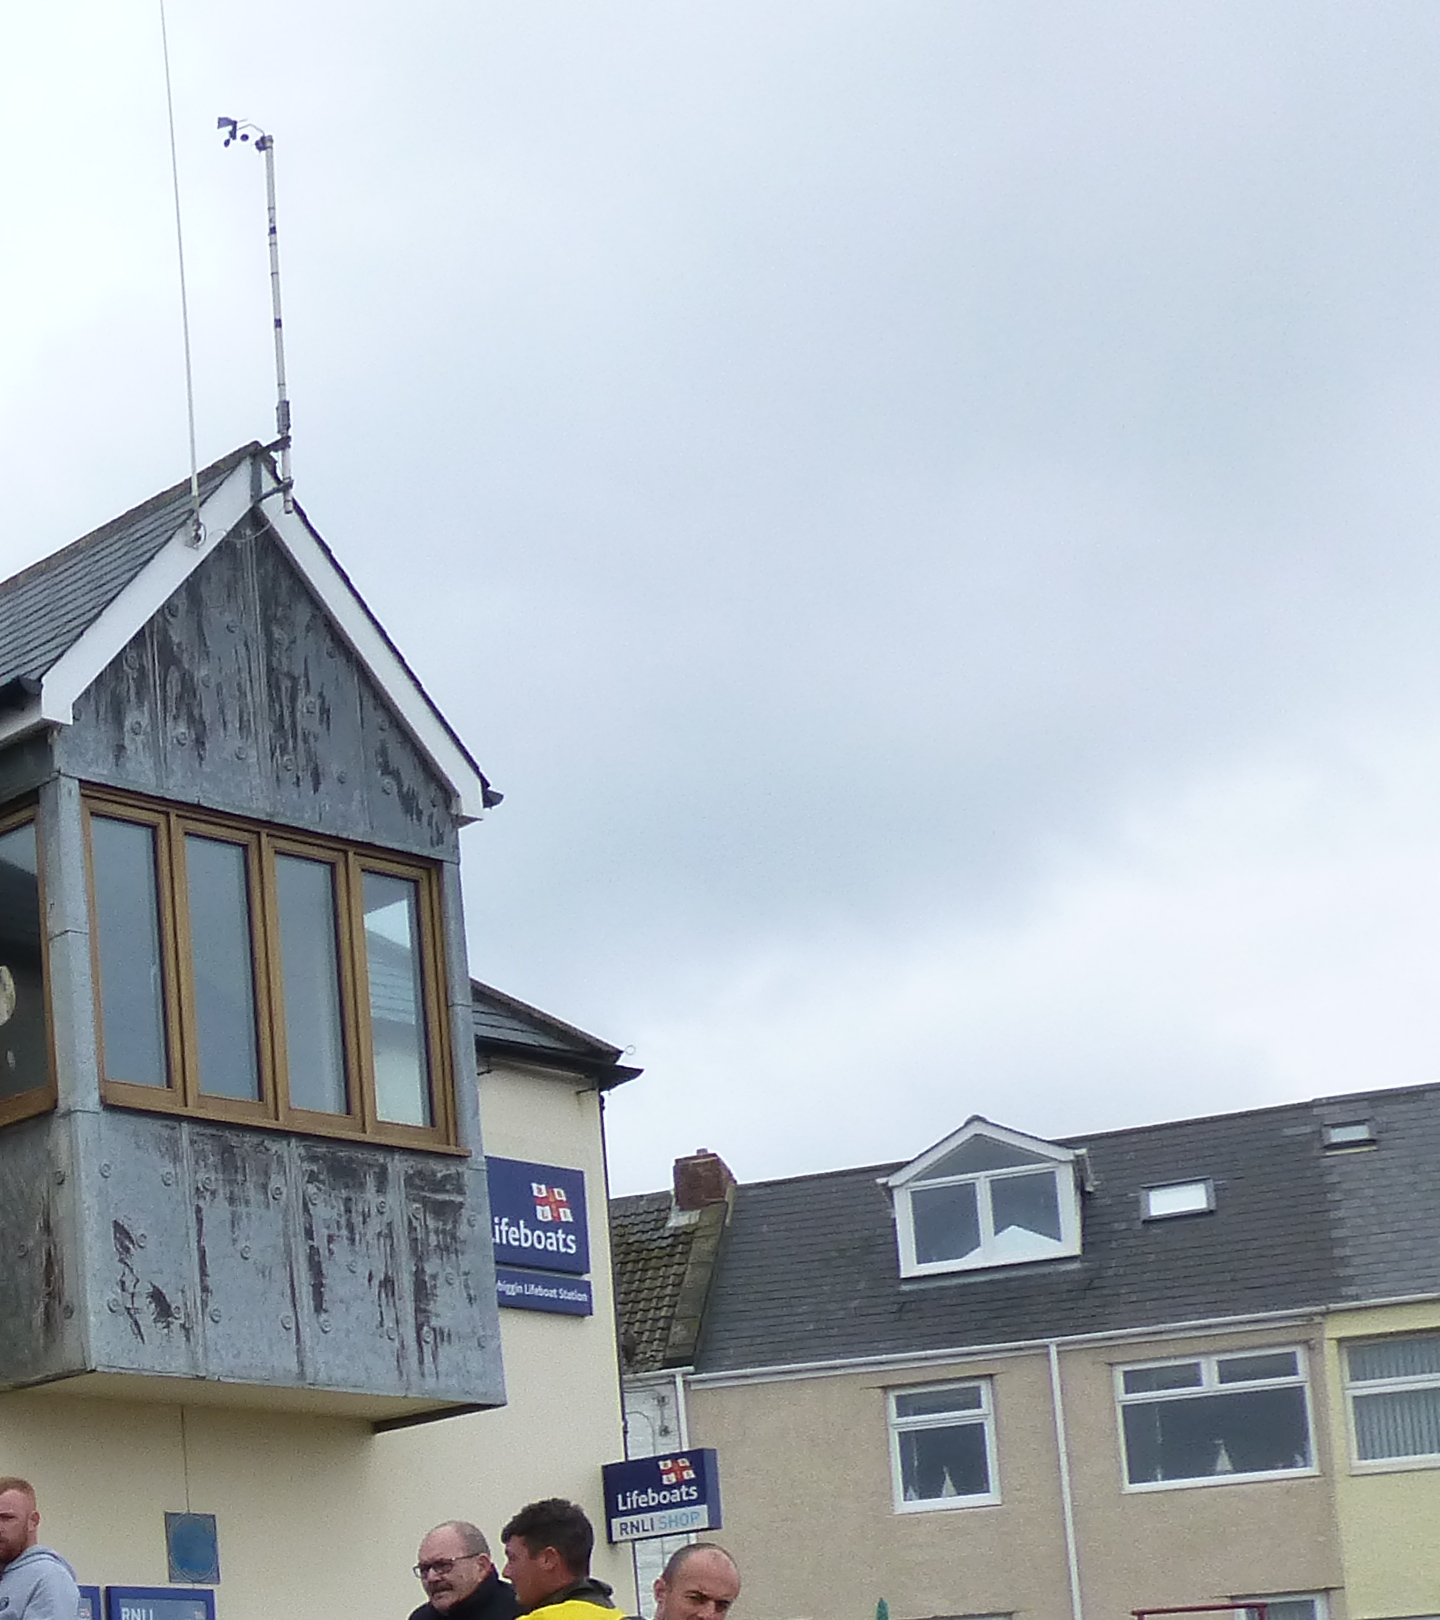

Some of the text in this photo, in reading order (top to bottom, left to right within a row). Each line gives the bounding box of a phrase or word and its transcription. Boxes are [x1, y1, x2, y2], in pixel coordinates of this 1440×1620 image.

[492, 1216, 577, 1255] ifeboats
[524, 1283, 558, 1299] Lifeboat
[559, 1287, 589, 1303] Station
[617, 1484, 698, 1511] Lifeboats
[619, 1511, 700, 1536] RNLI SHOP
